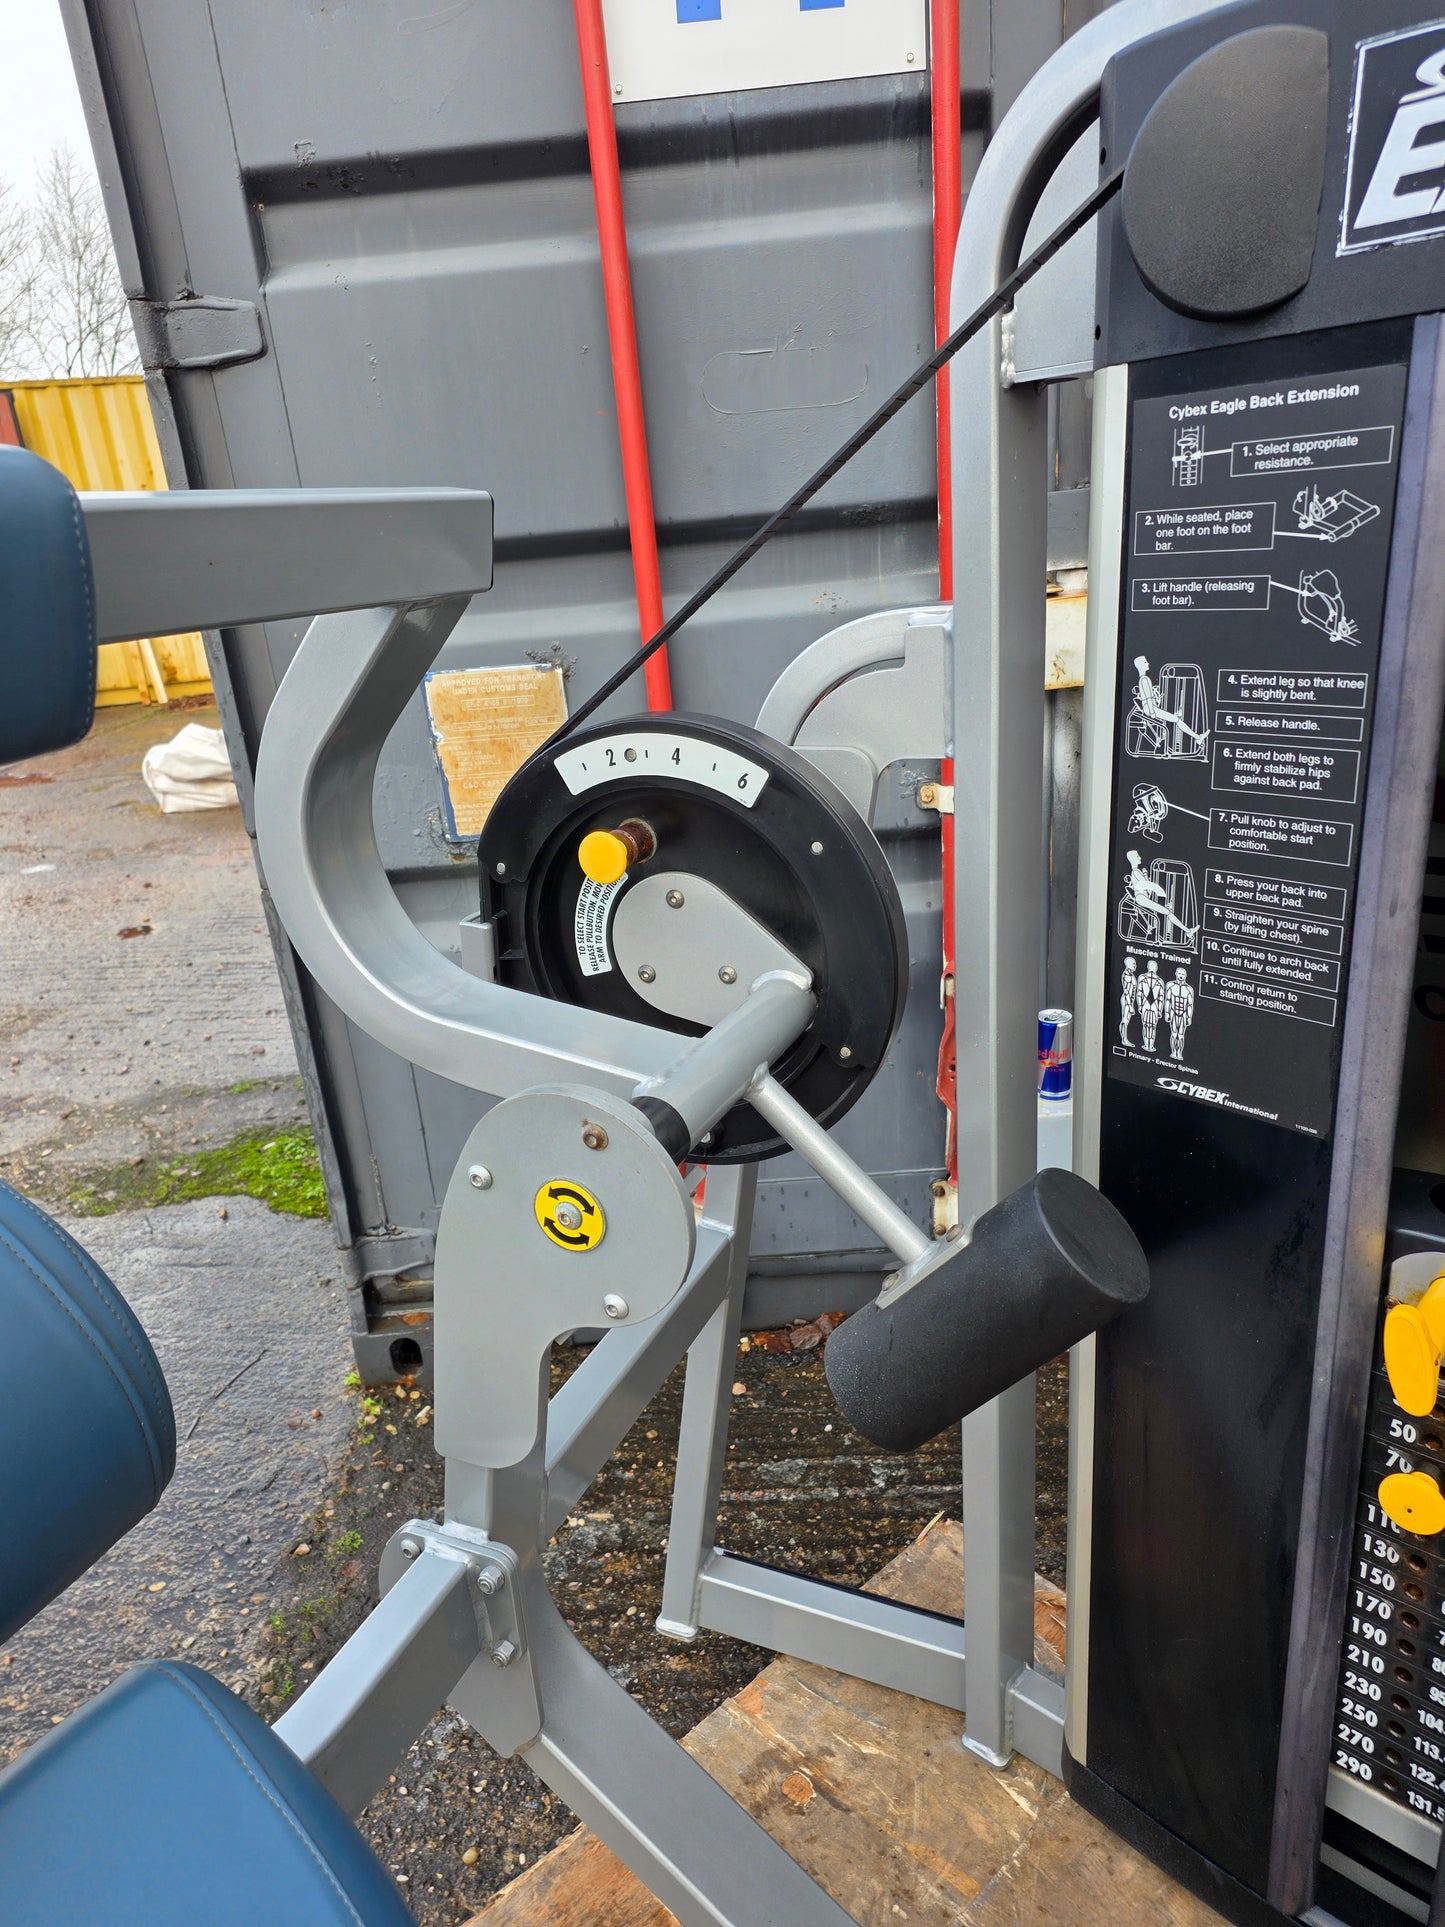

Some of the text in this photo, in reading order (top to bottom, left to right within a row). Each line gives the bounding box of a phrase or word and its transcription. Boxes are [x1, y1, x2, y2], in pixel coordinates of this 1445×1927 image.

[1169, 384, 1359, 421] Cybex Eagle Back Extension
[1243, 436, 1358, 456] 1. Select appropriate
[1255, 456, 1313, 470] resistance.
[1145, 510, 1253, 525] 2. While seated, place
[1156, 523, 1251, 537] one foot on the foot
[1156, 541, 1173, 550] bar.
[1142, 580, 1254, 593] 3. Lift handle (releasing
[1152, 595, 1194, 606] foot bar).
[1228, 675, 1237, 684] 4.
[1241, 675, 1276, 685] Extend
[1279, 676, 1295, 688] leg
[1314, 677, 1334, 687] that
[1337, 678, 1364, 689] knee
[1241, 688, 1316, 701] is slightly bent.
[1226, 716, 1320, 730] 5. Release handle.
[1224, 748, 1334, 766] 6. Extend both legs to
[606, 748, 748, 789] 2 4 6
[1235, 761, 1330, 779] firmly stabilize hips
[1234, 775, 1322, 790] against back pad.
[1219, 813, 1336, 834] 7. Pull knob to adjust to
[1229, 840, 1269, 851] position.
[1230, 828, 1313, 844] comfortable start
[582, 878, 594, 898] POSIT
[592, 883, 604, 899] MOV
[1215, 874, 1327, 899] 8. Press your back into
[1226, 889, 1303, 908] upper back pad.
[578, 899, 587, 920] START
[595, 905, 605, 933] DESIRED
[1214, 908, 1329, 936] 9. Straighten your spine
[1225, 921, 1302, 944] (by lifting chest).
[595, 935, 602, 944] TO
[579, 946, 585, 955] TO
[587, 945, 599, 971] RELEASE
[596, 946, 606, 963] ARM
[1127, 946, 1190, 964] Muscles Trained
[1206, 941, 1328, 972] 10. Continue to arch back
[1222, 957, 1314, 981] until fully extended.
[1204, 974, 1297, 1001] 11. Control return to
[1220, 990, 1296, 1013] starting position.
[1129, 1052, 1151, 1062] Primary
[1156, 1059, 1177, 1068] Erector
[1178, 1065, 1198, 1074] Spinae
[1177, 1082, 1278, 1120] CYBEX International
[1390, 1419, 1416, 1442] 50
[1364, 1534, 1400, 1563] 130
[1360, 1562, 1395, 1590] 150
[1356, 1590, 1393, 1619] 170
[1352, 1617, 1387, 1646] 190
[1348, 1645, 1384, 1673] 210
[1345, 1672, 1381, 1700] 230
[1342, 1698, 1378, 1727] 250
[1338, 1724, 1374, 1753] 270
[1414, 1736, 1445, 1763] 113.
[1336, 1751, 1372, 1780] 290
